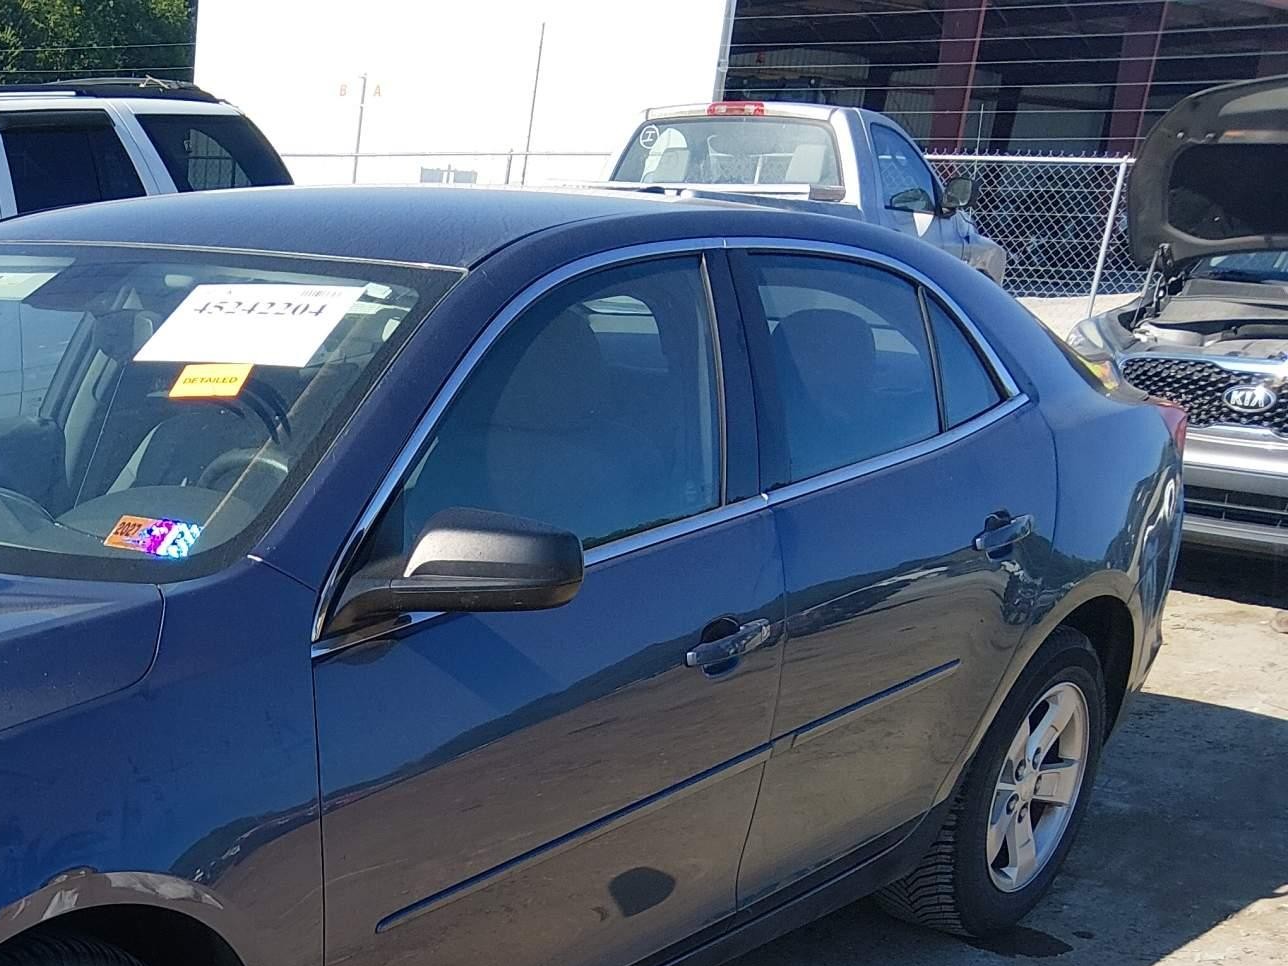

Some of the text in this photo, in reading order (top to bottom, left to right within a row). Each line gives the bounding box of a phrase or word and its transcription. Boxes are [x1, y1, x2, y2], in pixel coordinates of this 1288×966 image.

[193, 301, 328, 317] 45242204
[182, 376, 238, 385] DETAILED
[1230, 388, 1266, 408] KIA
[114, 521, 142, 536] 2027
